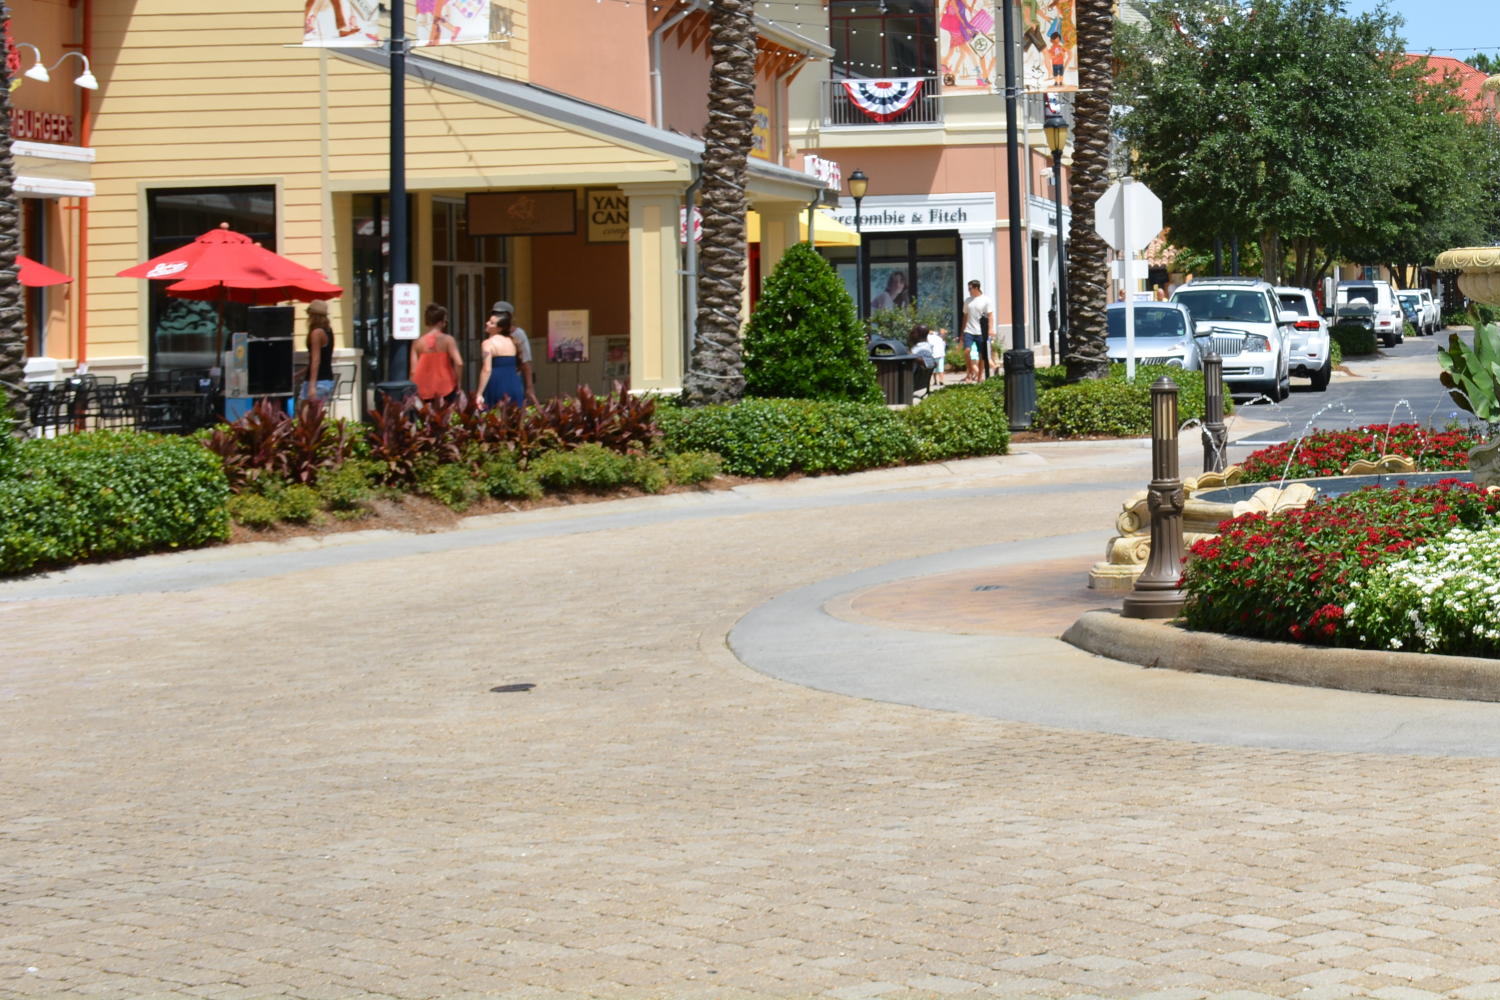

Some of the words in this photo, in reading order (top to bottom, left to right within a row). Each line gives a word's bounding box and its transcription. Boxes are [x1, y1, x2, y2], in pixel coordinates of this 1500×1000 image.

[593, 196, 629, 210] YAN
[592, 211, 629, 225] CAN
[929, 207, 967, 222] Fitch
